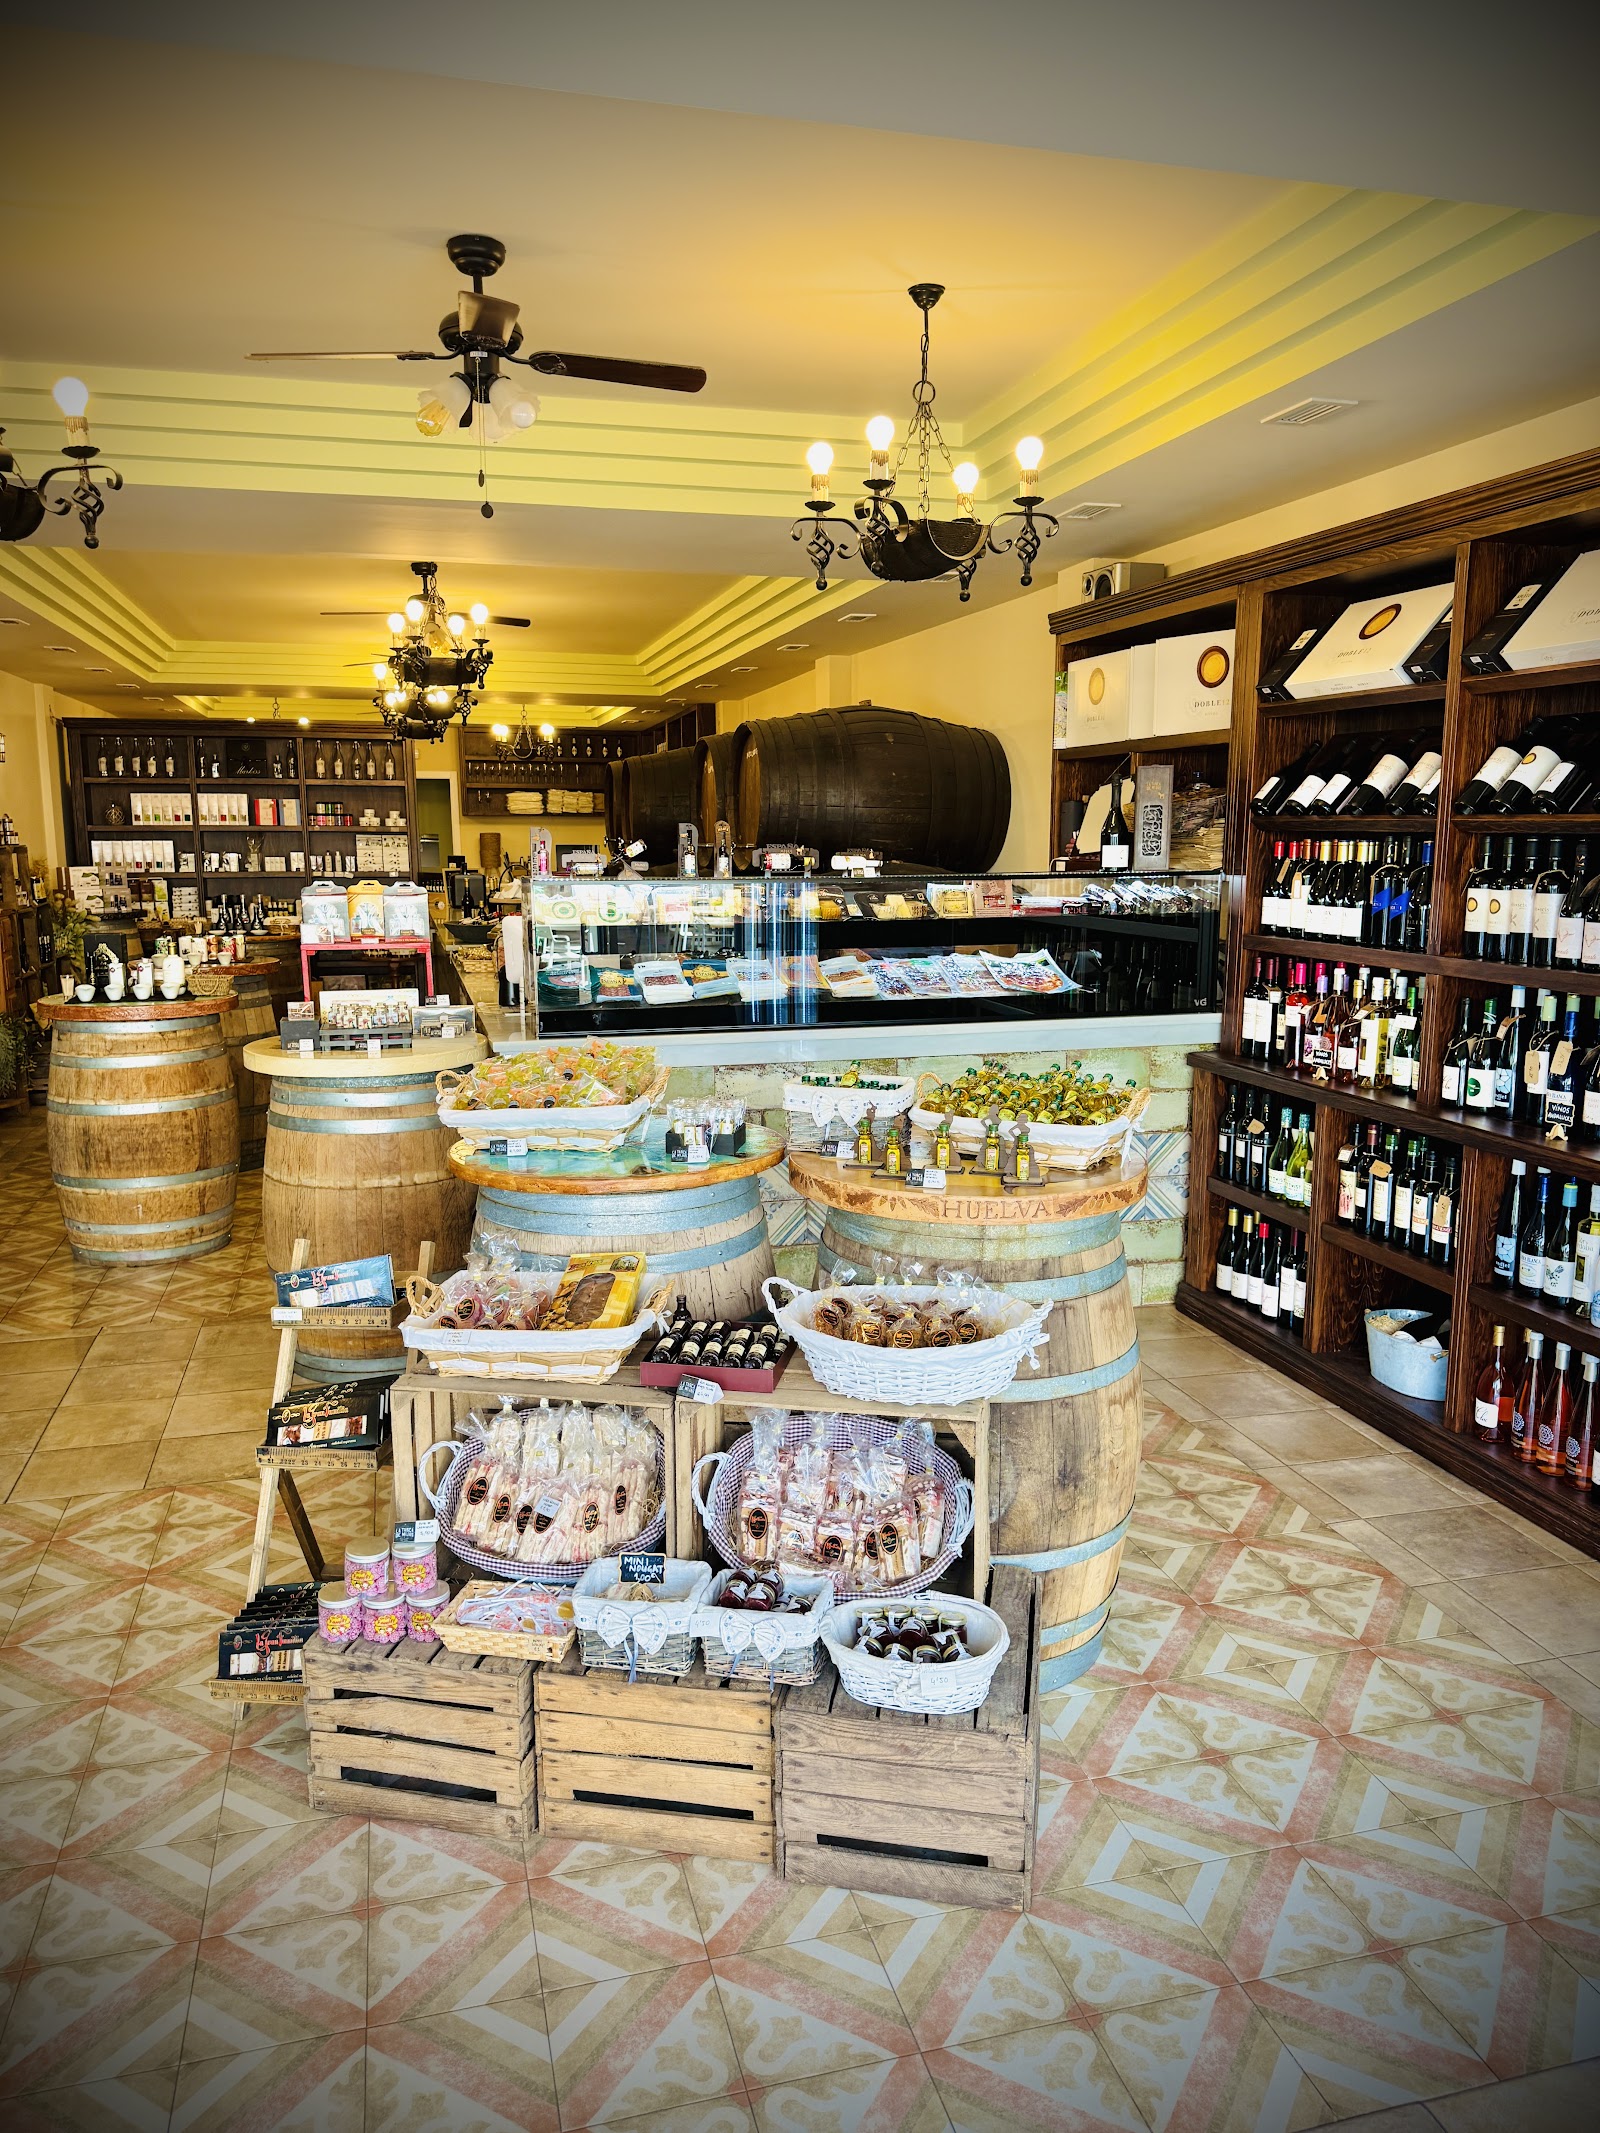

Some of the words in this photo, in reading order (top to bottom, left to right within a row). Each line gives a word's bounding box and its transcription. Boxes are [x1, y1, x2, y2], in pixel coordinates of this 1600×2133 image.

[941, 1199, 1051, 1219] HUELVA
[624, 1556, 649, 1566] MINI
[628, 1564, 663, 1574] NOUGAT
